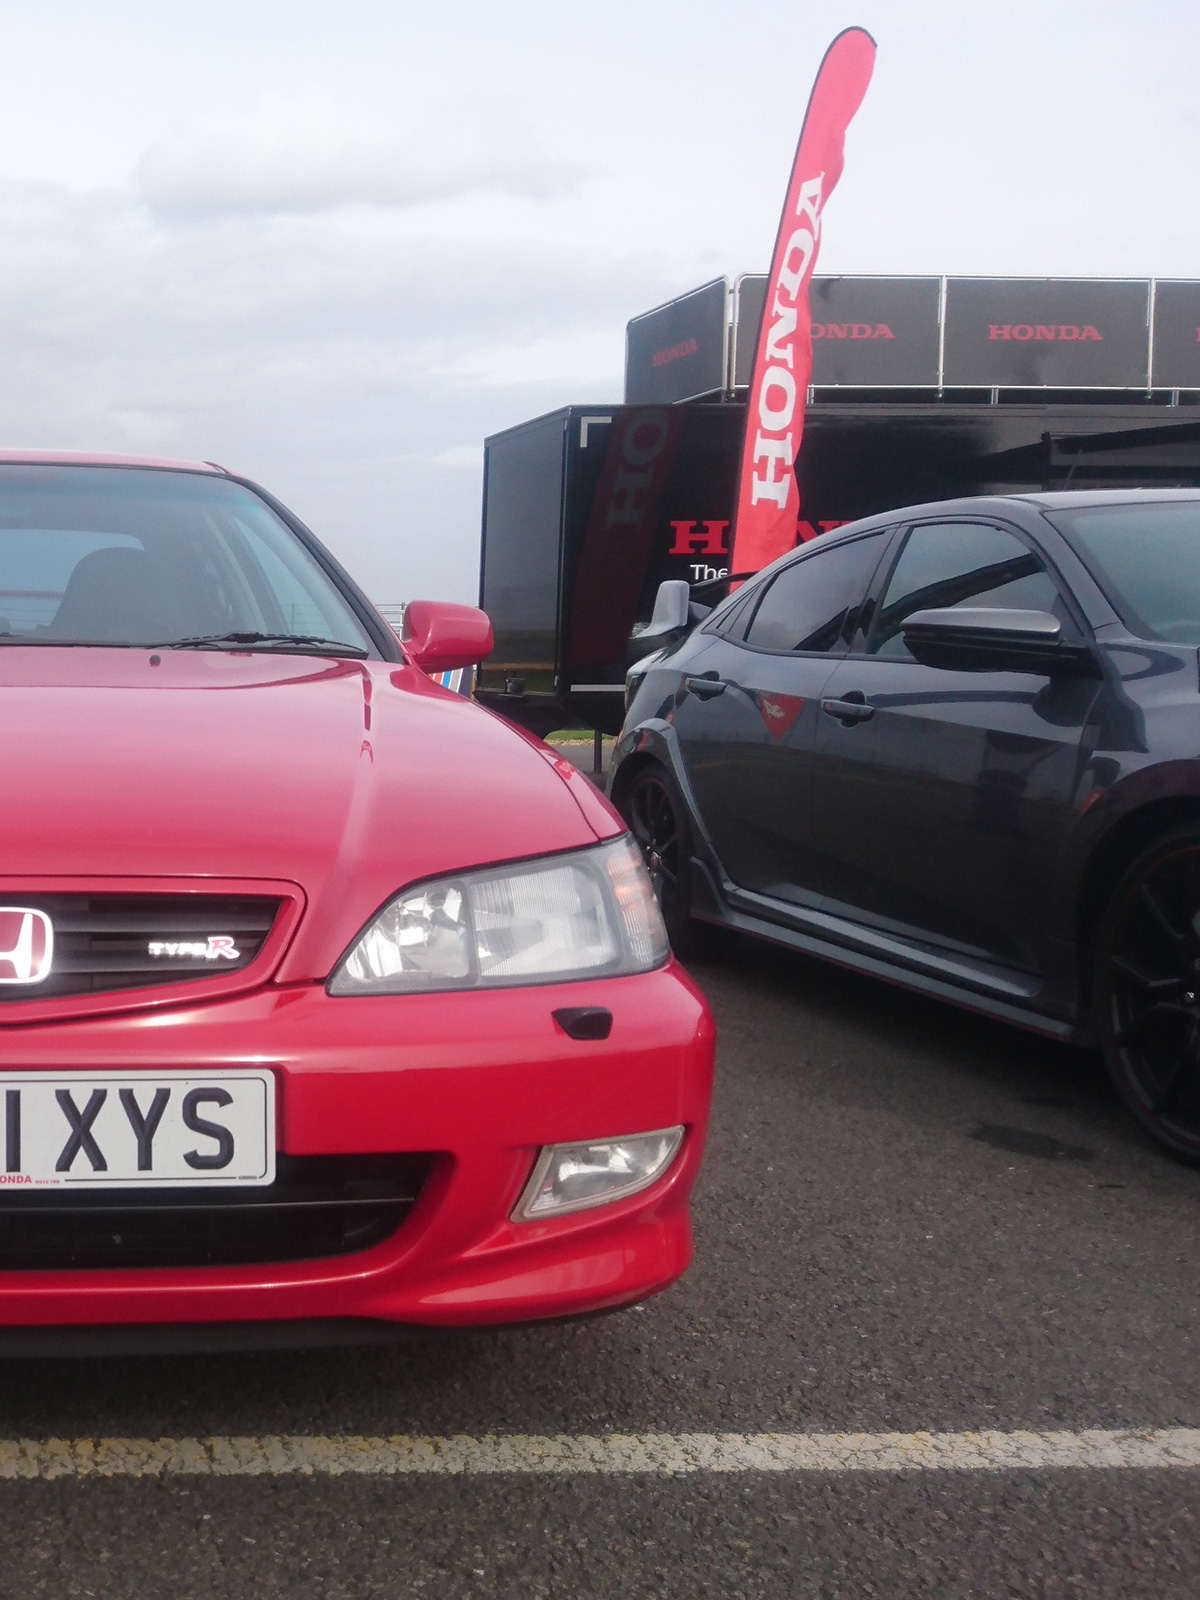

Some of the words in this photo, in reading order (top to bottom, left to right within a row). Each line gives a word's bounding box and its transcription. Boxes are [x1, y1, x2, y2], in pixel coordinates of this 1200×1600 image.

[751, 171, 826, 509] HONDA
[811, 323, 897, 340] ONDA
[987, 324, 1104, 341] HONDA
[651, 339, 699, 369] HONDA
[55, 1086, 236, 1173] XYS
